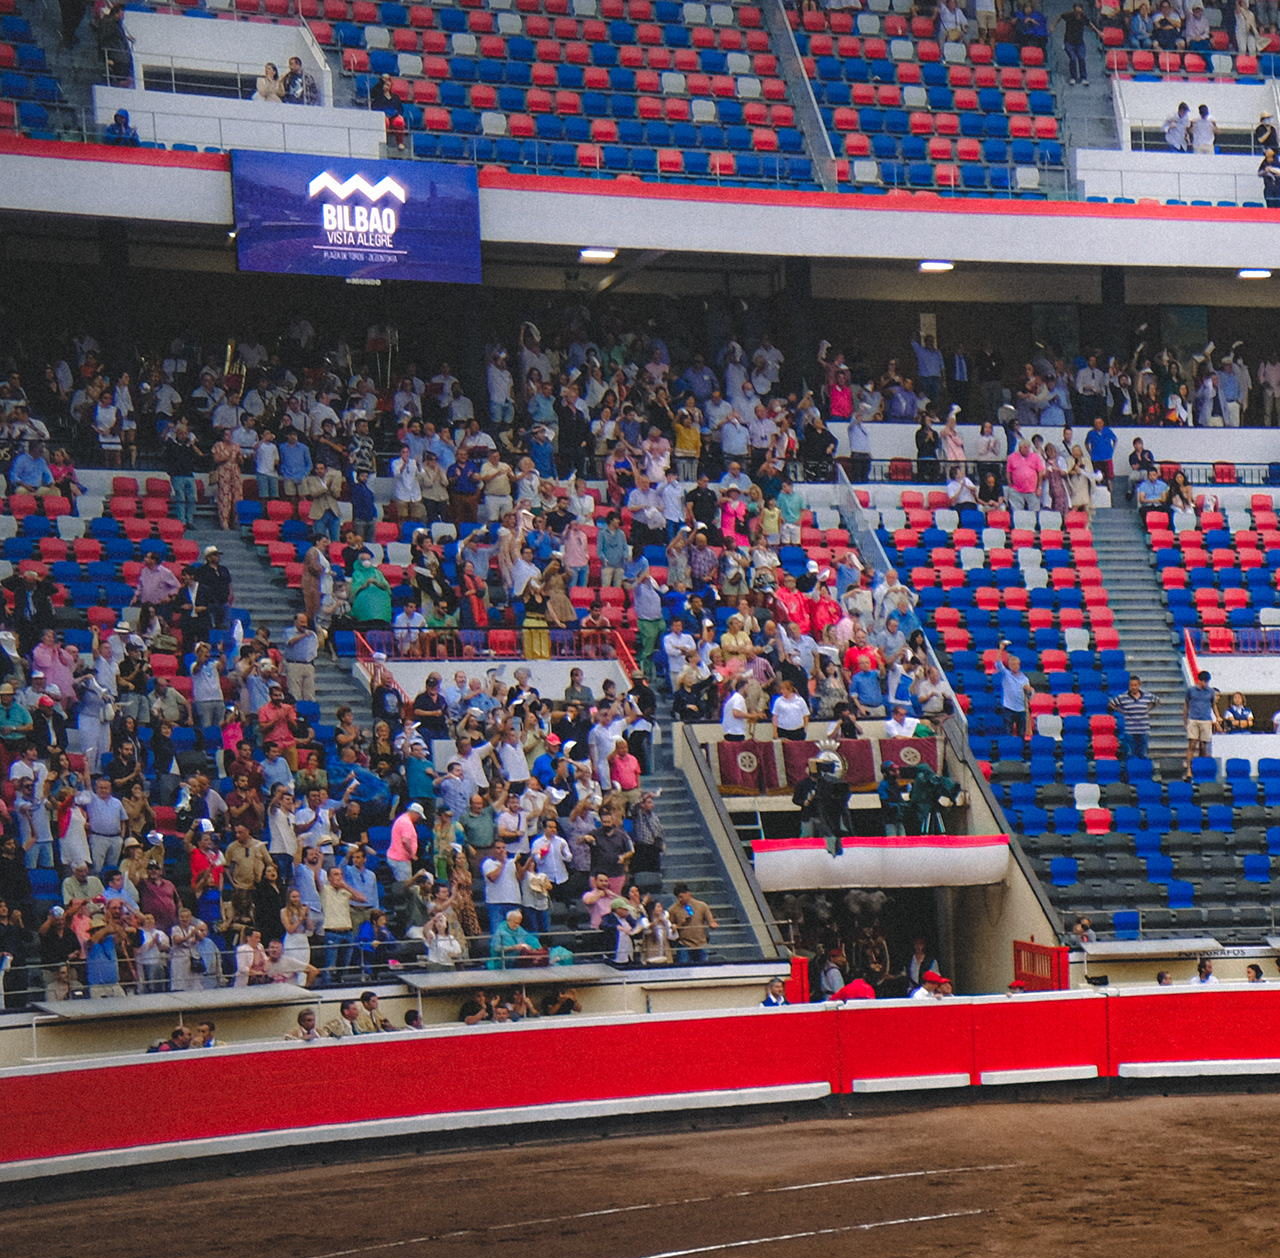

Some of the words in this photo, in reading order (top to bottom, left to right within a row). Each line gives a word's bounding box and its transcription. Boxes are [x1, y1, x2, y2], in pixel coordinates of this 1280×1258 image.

[322, 203, 396, 234] BILBAO
[327, 231, 355, 245] VISTA
[357, 233, 393, 248] ALEGRE
